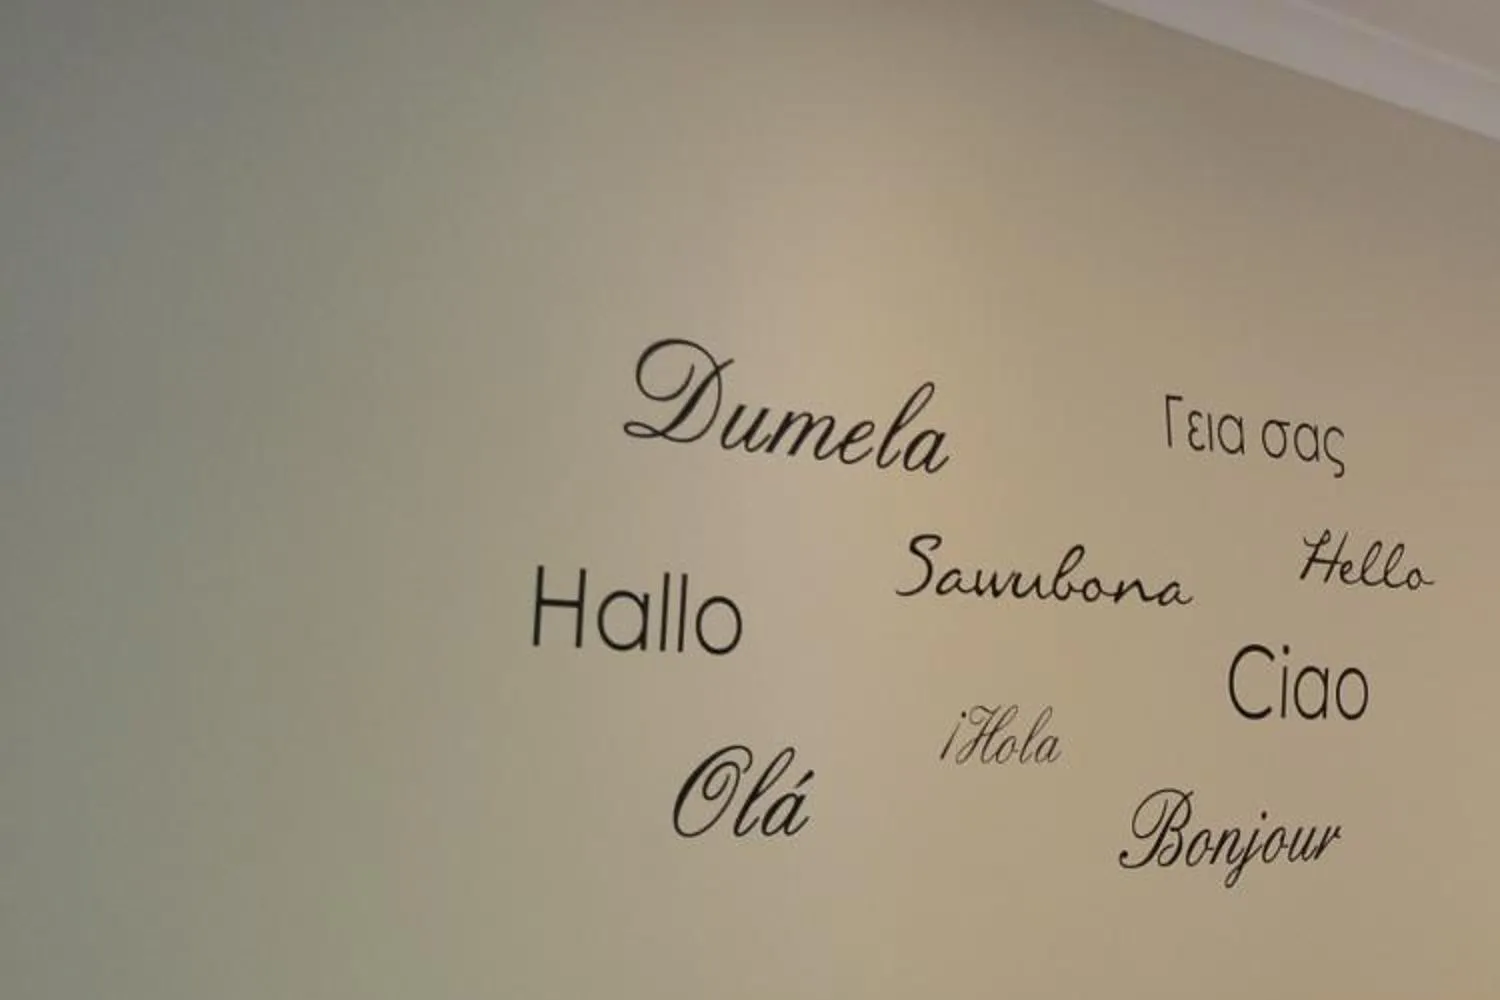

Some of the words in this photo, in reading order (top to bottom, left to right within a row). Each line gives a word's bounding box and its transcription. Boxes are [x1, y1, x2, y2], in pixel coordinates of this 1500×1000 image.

[622, 337, 950, 475] Dumela
[1164, 394, 1246, 456] Γεια
[1261, 418, 1345, 479] σας
[895, 533, 1194, 607] Sawubona
[1299, 528, 1435, 591] Hello
[531, 564, 743, 656] Hallo
[1228, 643, 1369, 721] Ciao
[672, 744, 815, 839] Olá
[1118, 787, 1342, 889] Bonjour
